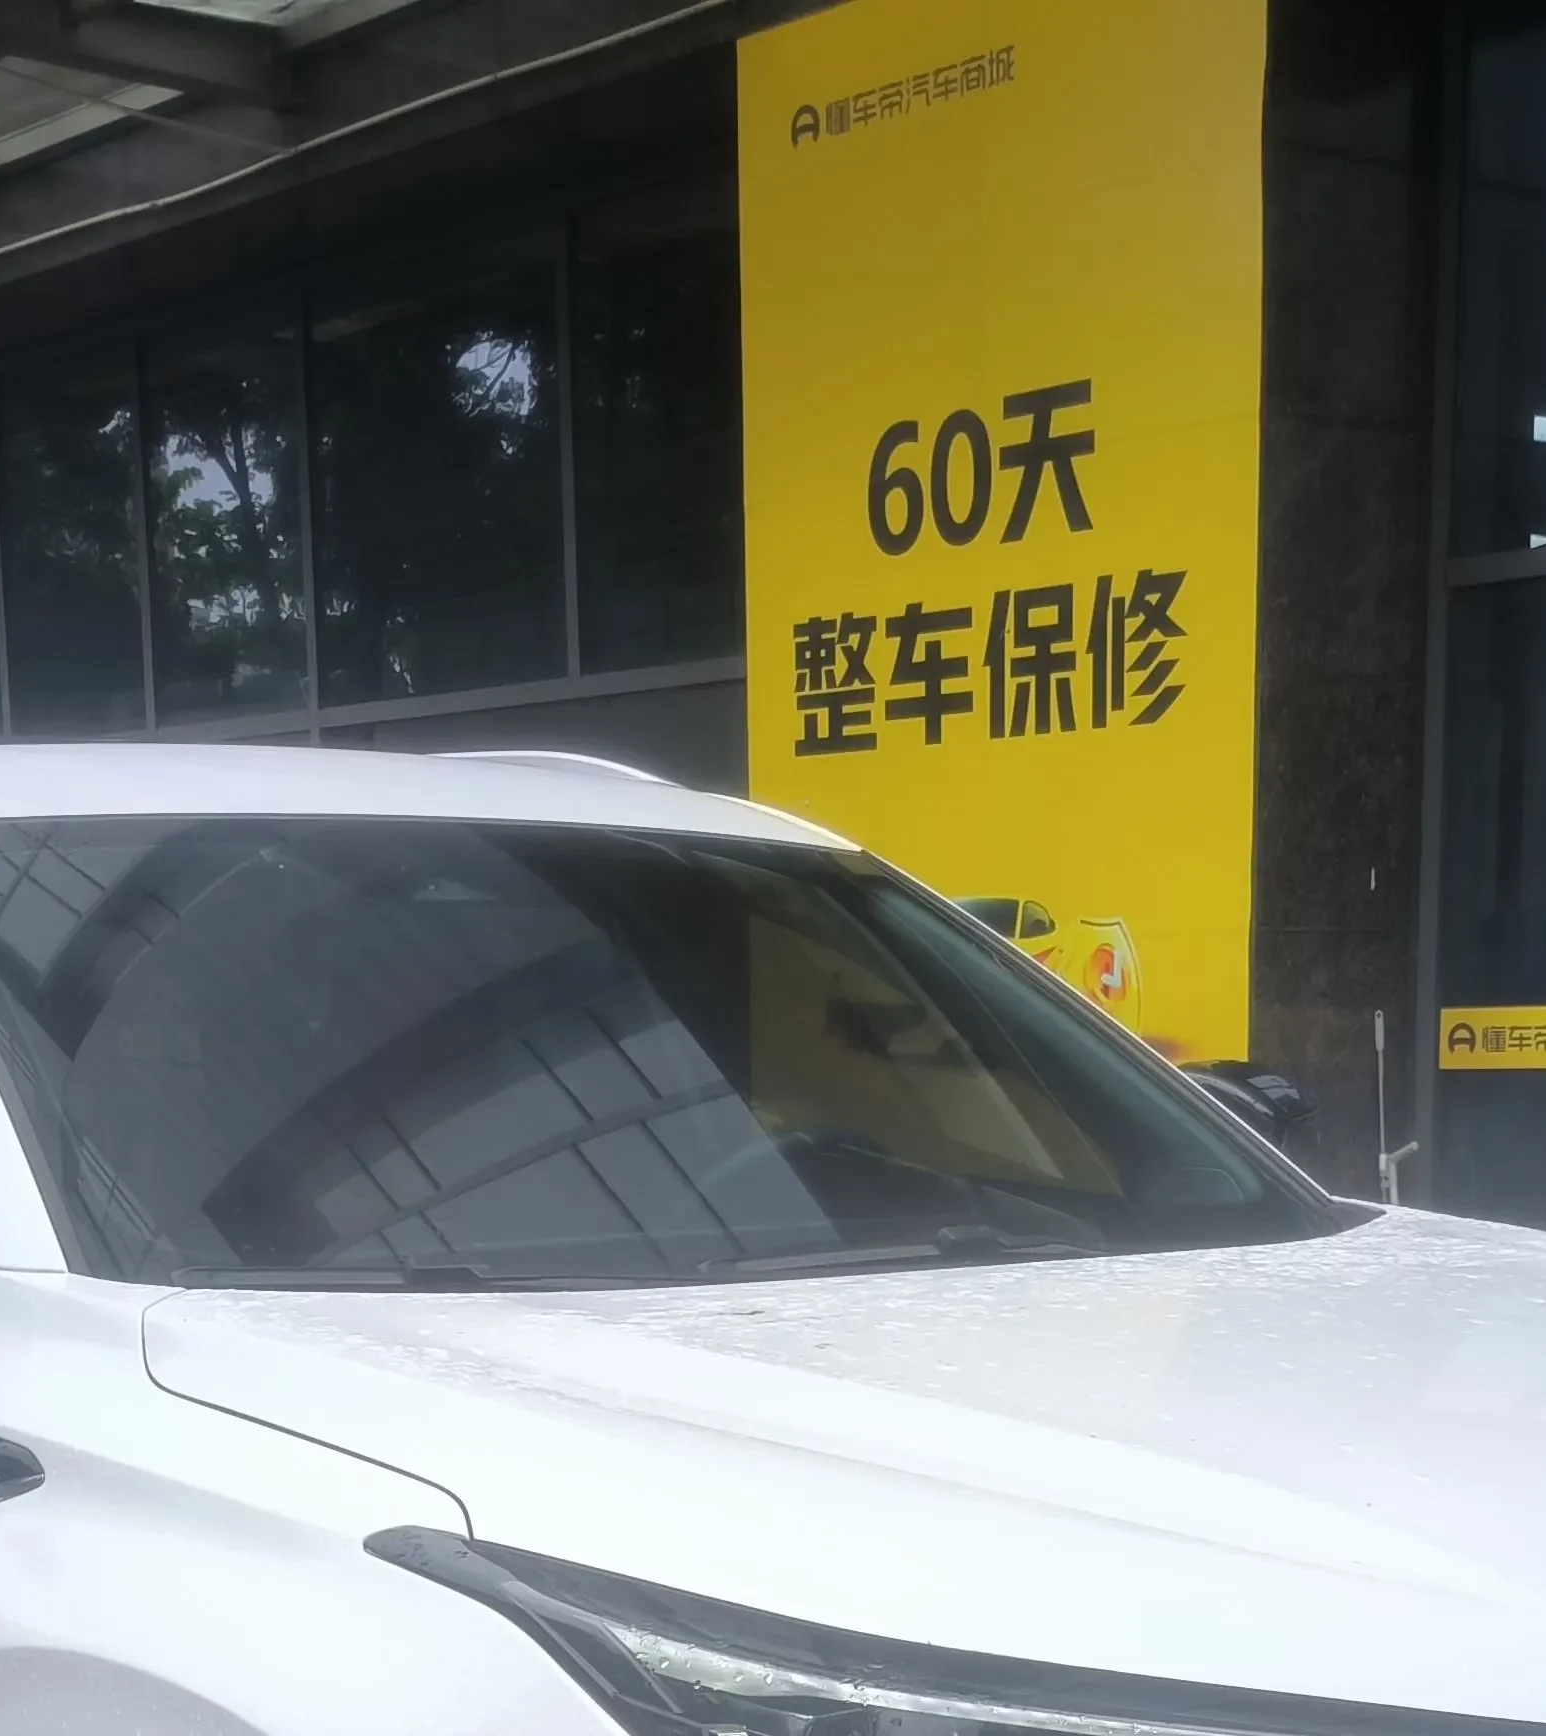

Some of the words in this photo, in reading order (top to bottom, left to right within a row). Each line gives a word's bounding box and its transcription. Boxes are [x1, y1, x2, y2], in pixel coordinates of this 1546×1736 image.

[825, 45, 1016, 137] 懂车帝汽车商城
[866, 378, 1096, 556] 60天
[792, 567, 1189, 758] 整车保修
